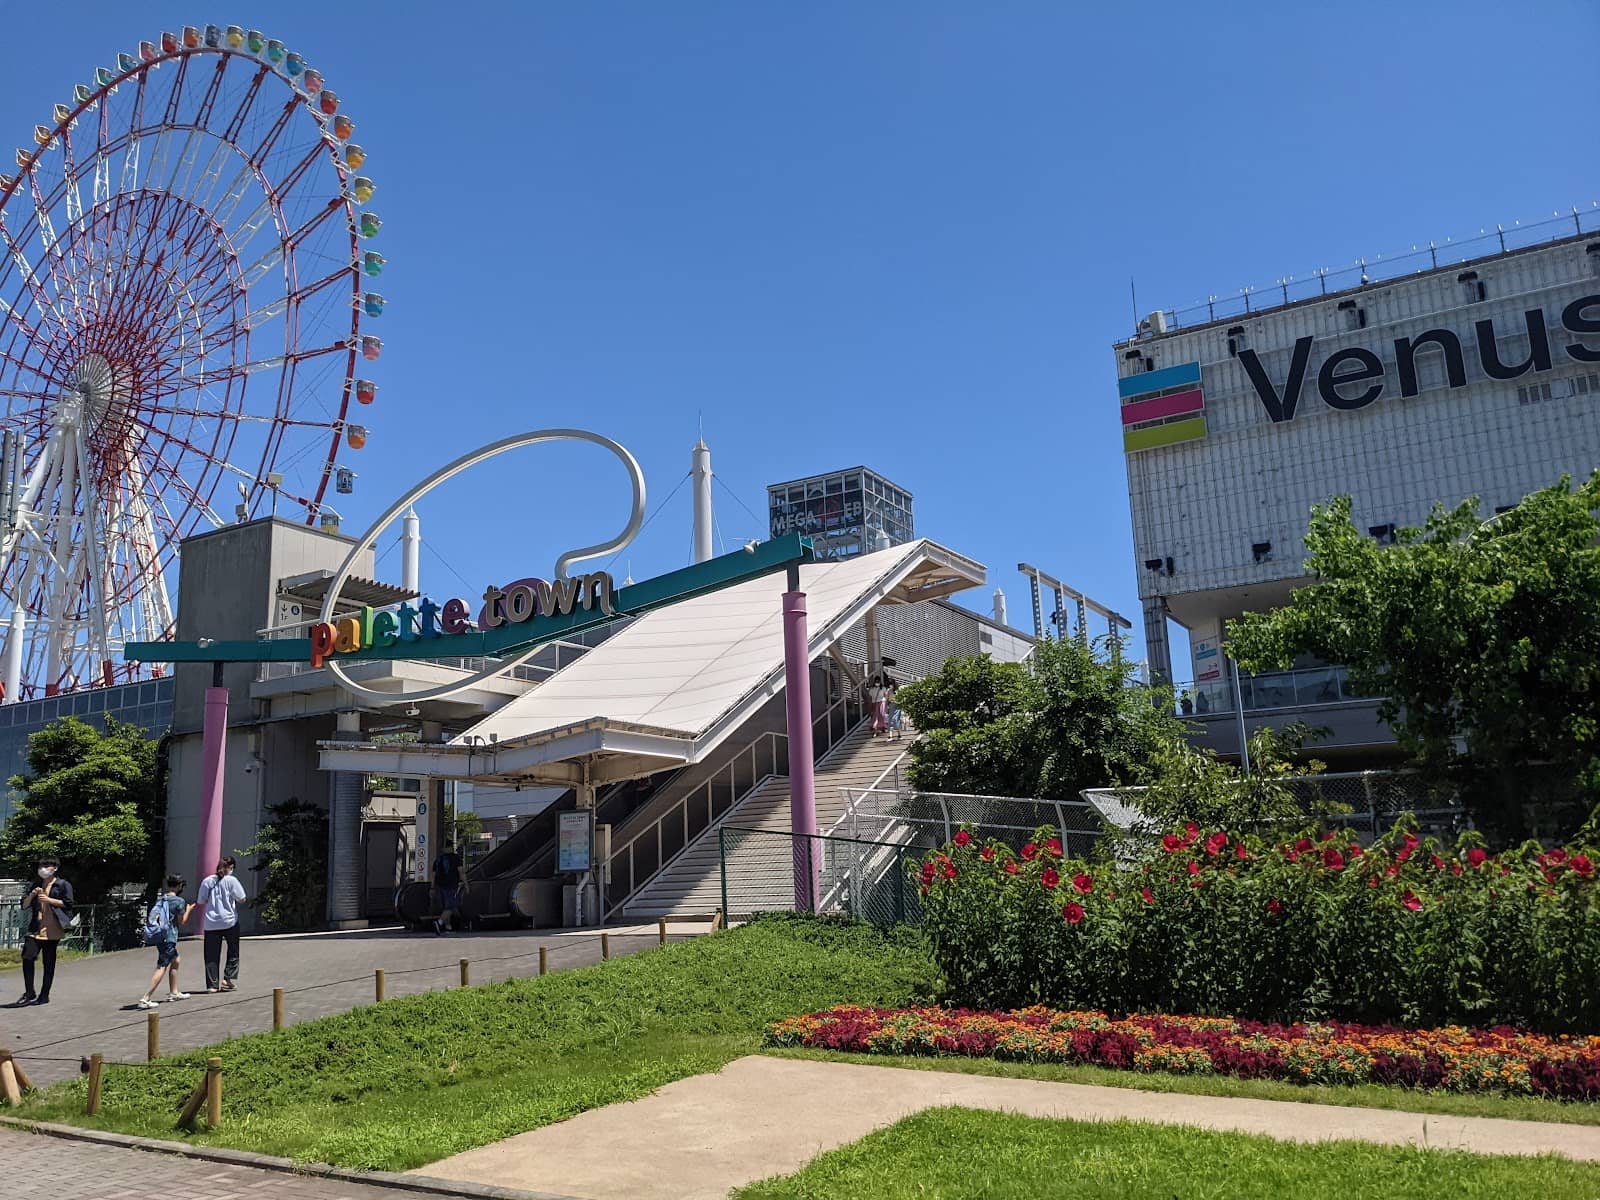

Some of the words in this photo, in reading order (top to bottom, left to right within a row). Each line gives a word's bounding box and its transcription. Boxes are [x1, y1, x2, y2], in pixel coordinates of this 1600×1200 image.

[1237, 294, 1600, 424] Venus
[772, 510, 817, 530] MEGA
[311, 596, 471, 668] palette
[483, 571, 615, 627] town
